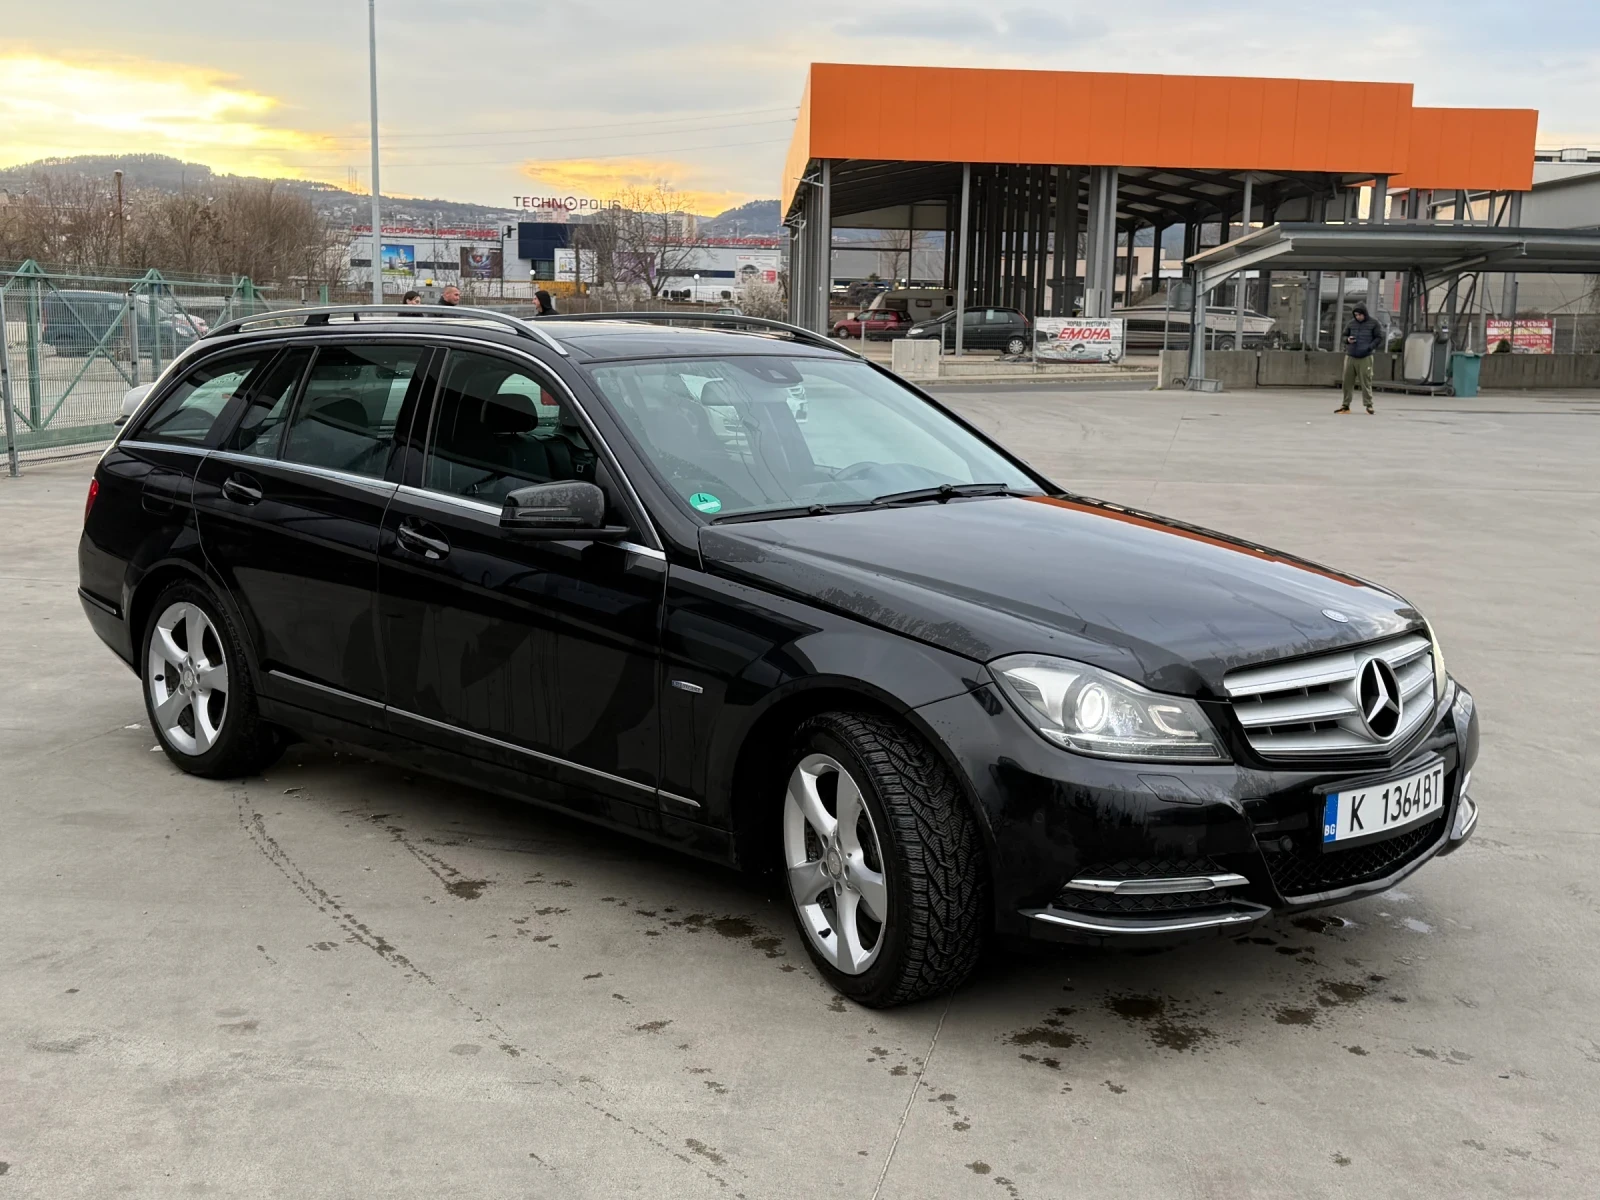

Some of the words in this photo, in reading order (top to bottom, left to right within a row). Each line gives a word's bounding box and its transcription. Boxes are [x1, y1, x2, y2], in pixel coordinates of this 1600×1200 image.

[513, 196, 621, 211] TECHNOPOLIS
[1058, 327, 1111, 340] ЕМОНА
[1349, 794, 1366, 832] K
[1324, 823, 1336, 837] BG
